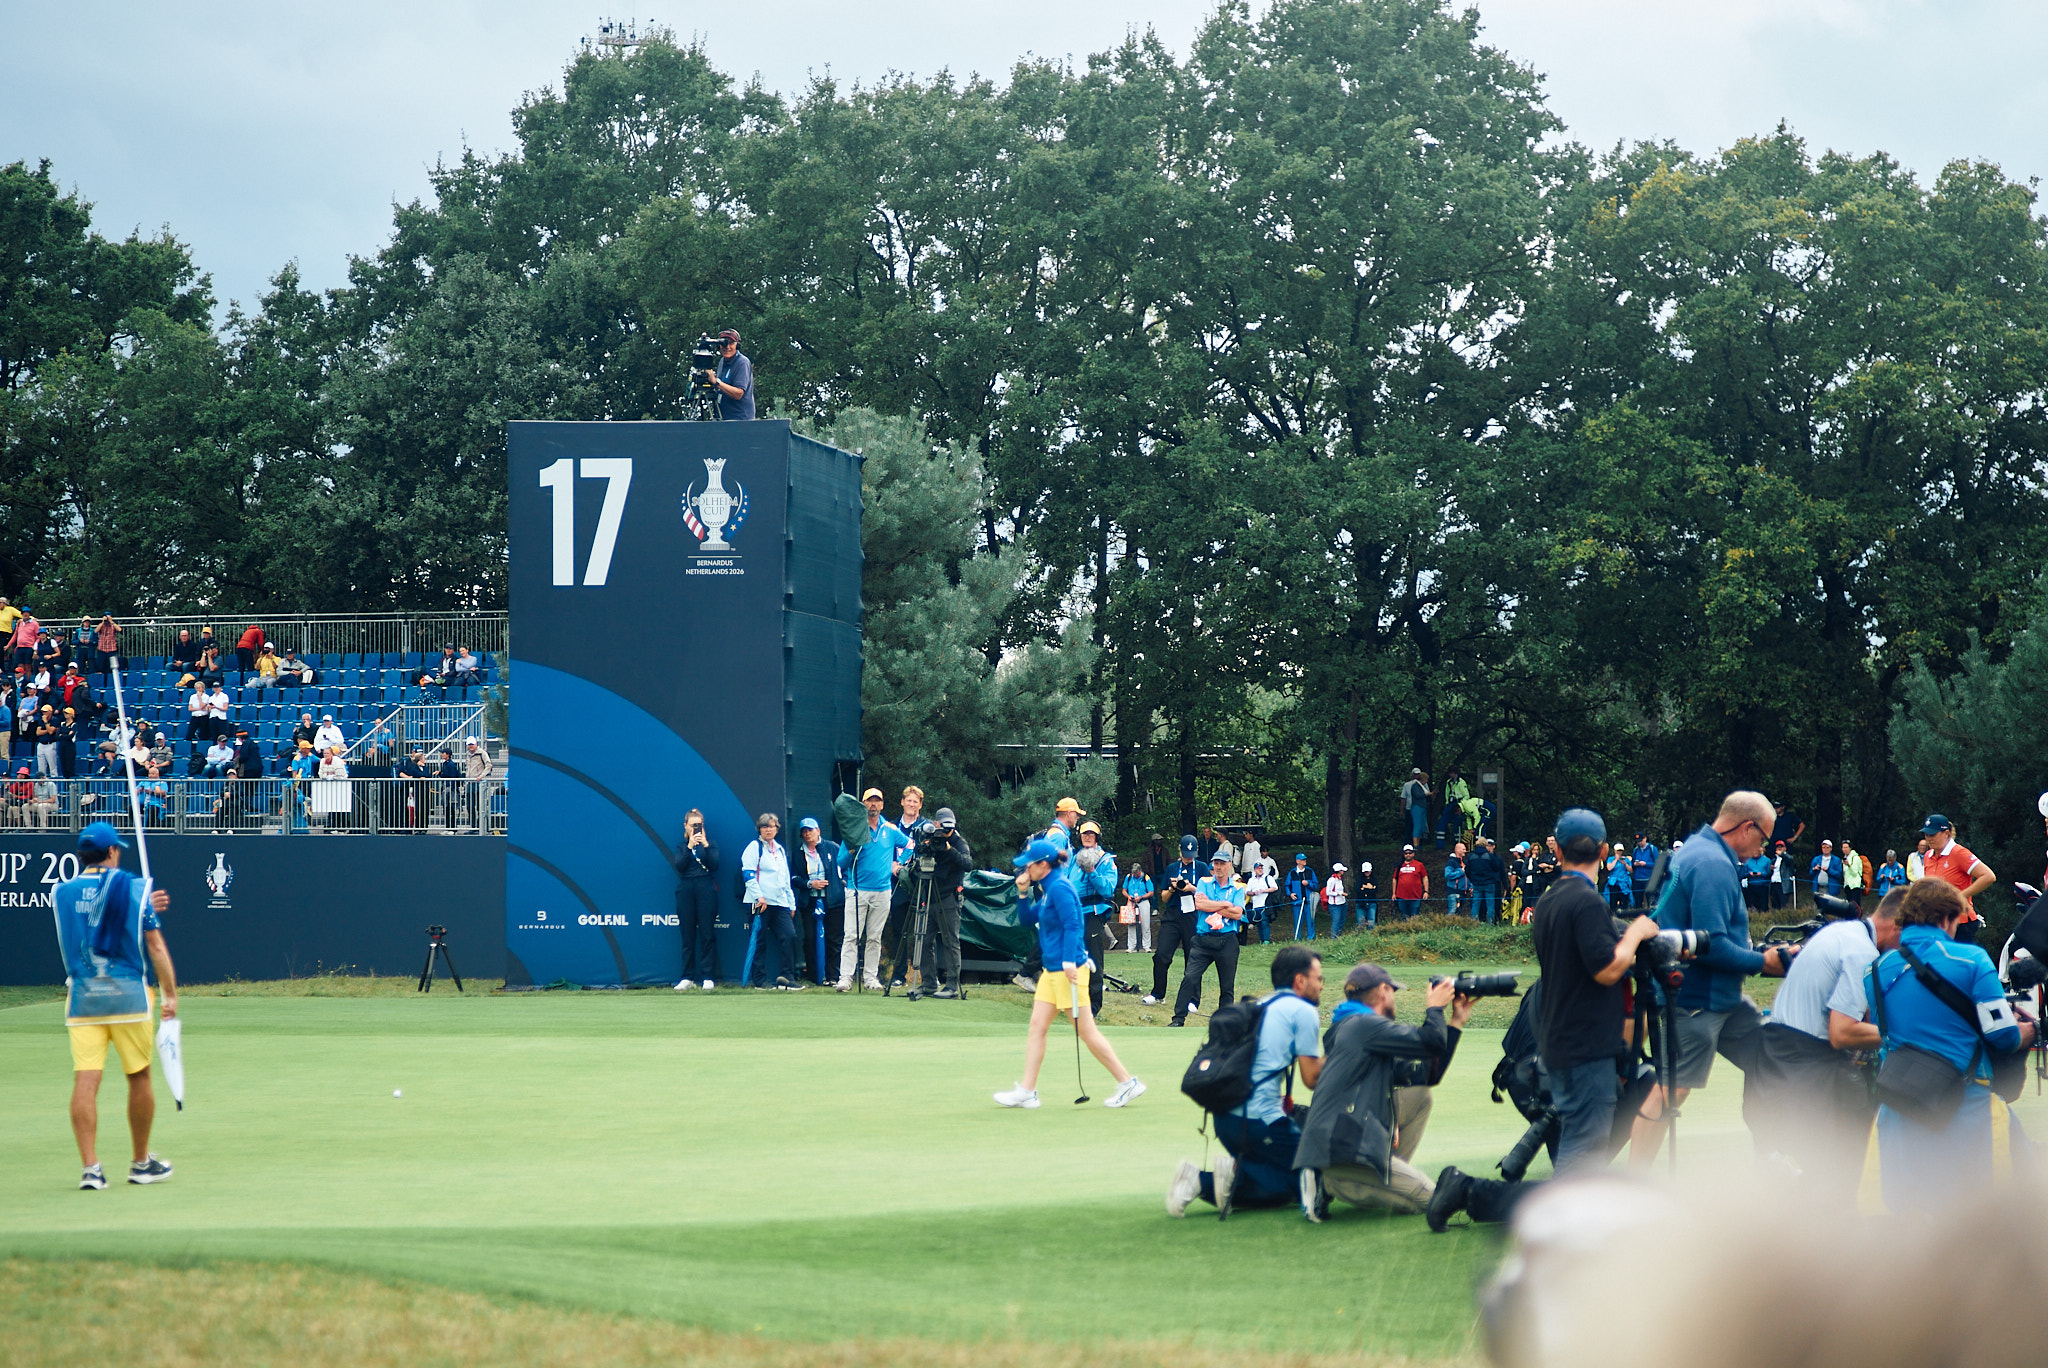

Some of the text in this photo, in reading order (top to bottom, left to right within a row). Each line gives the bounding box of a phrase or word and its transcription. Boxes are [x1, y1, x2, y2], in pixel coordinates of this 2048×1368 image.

[691, 496, 739, 507] SOLHEIM
[704, 506, 725, 515] CUP
[539, 458, 632, 586] 17
[577, 914, 629, 926] GOLF.NL
[641, 914, 680, 926] PING
